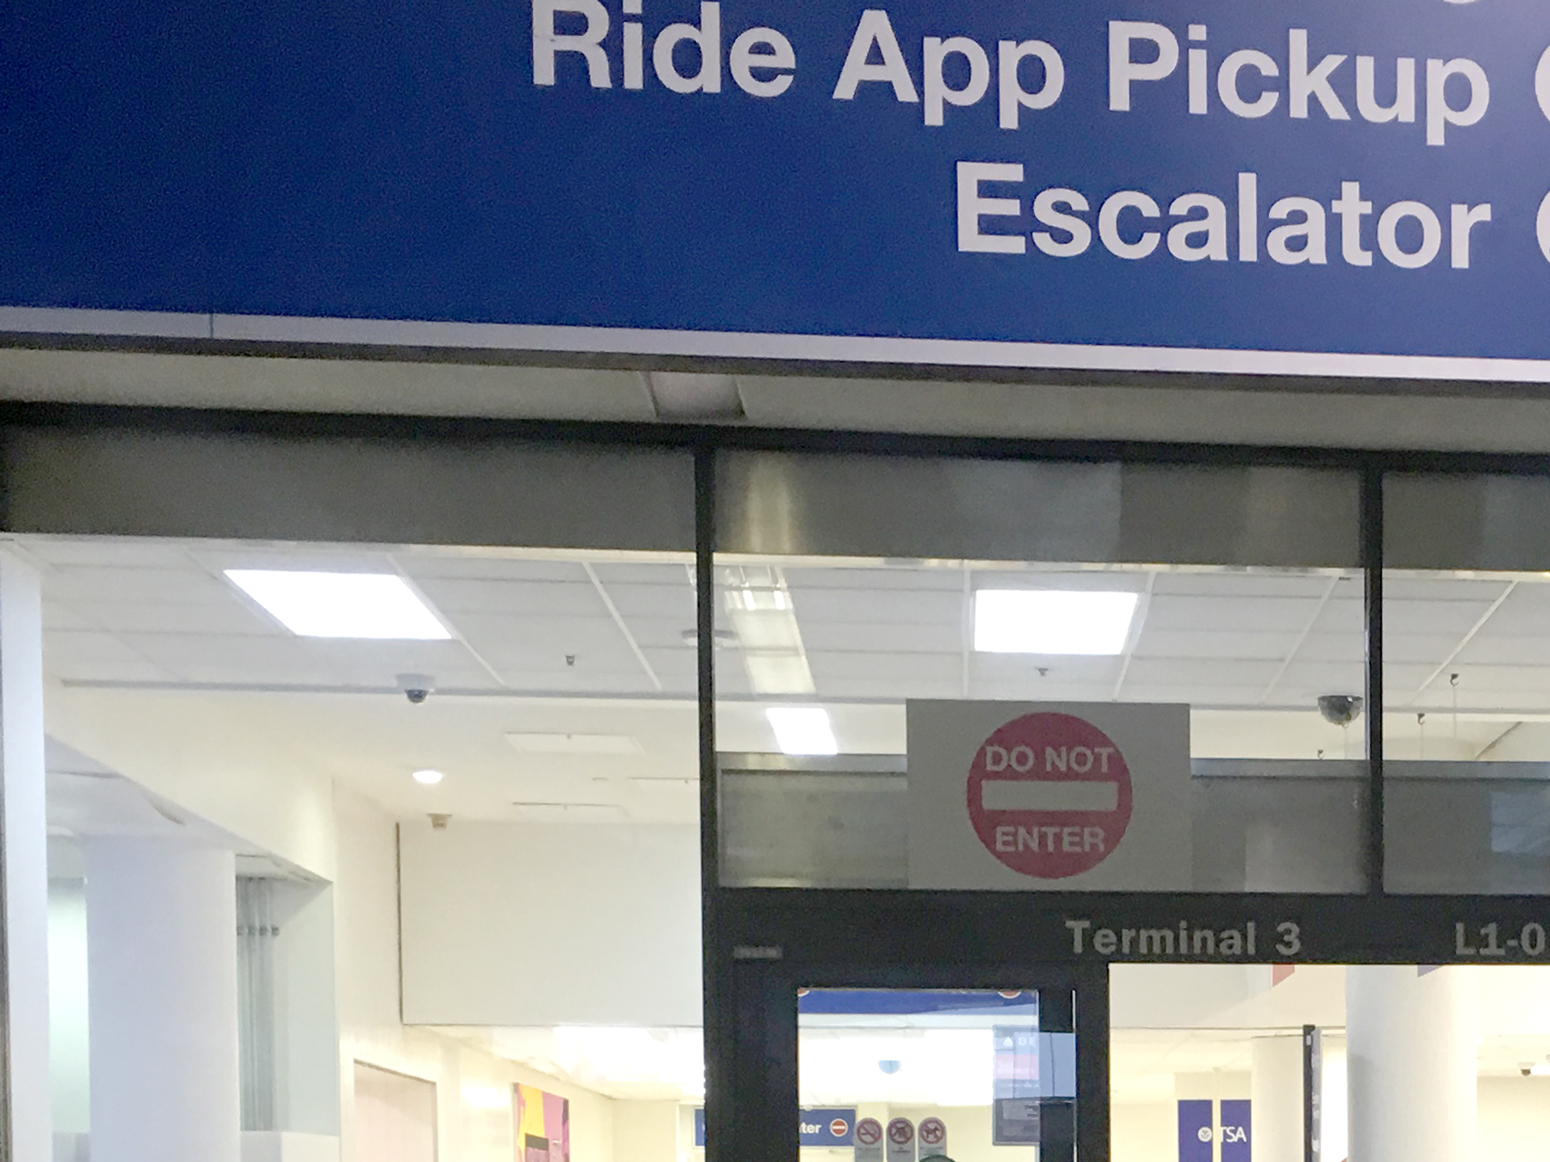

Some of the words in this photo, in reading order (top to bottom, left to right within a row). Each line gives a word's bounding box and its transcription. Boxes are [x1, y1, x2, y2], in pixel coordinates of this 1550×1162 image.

[531, 0, 796, 98] Ride
[832, 9, 1065, 129] App
[1108, 20, 1490, 146] Pickup
[956, 160, 1491, 269] Escalator
[985, 745, 1034, 773] DO
[1045, 746, 1113, 773] NOT
[995, 826, 1105, 852] ENTER
[1065, 920, 1256, 955] Terminal
[1275, 921, 1301, 955] 3
[1220, 1126, 1247, 1143] TSA
